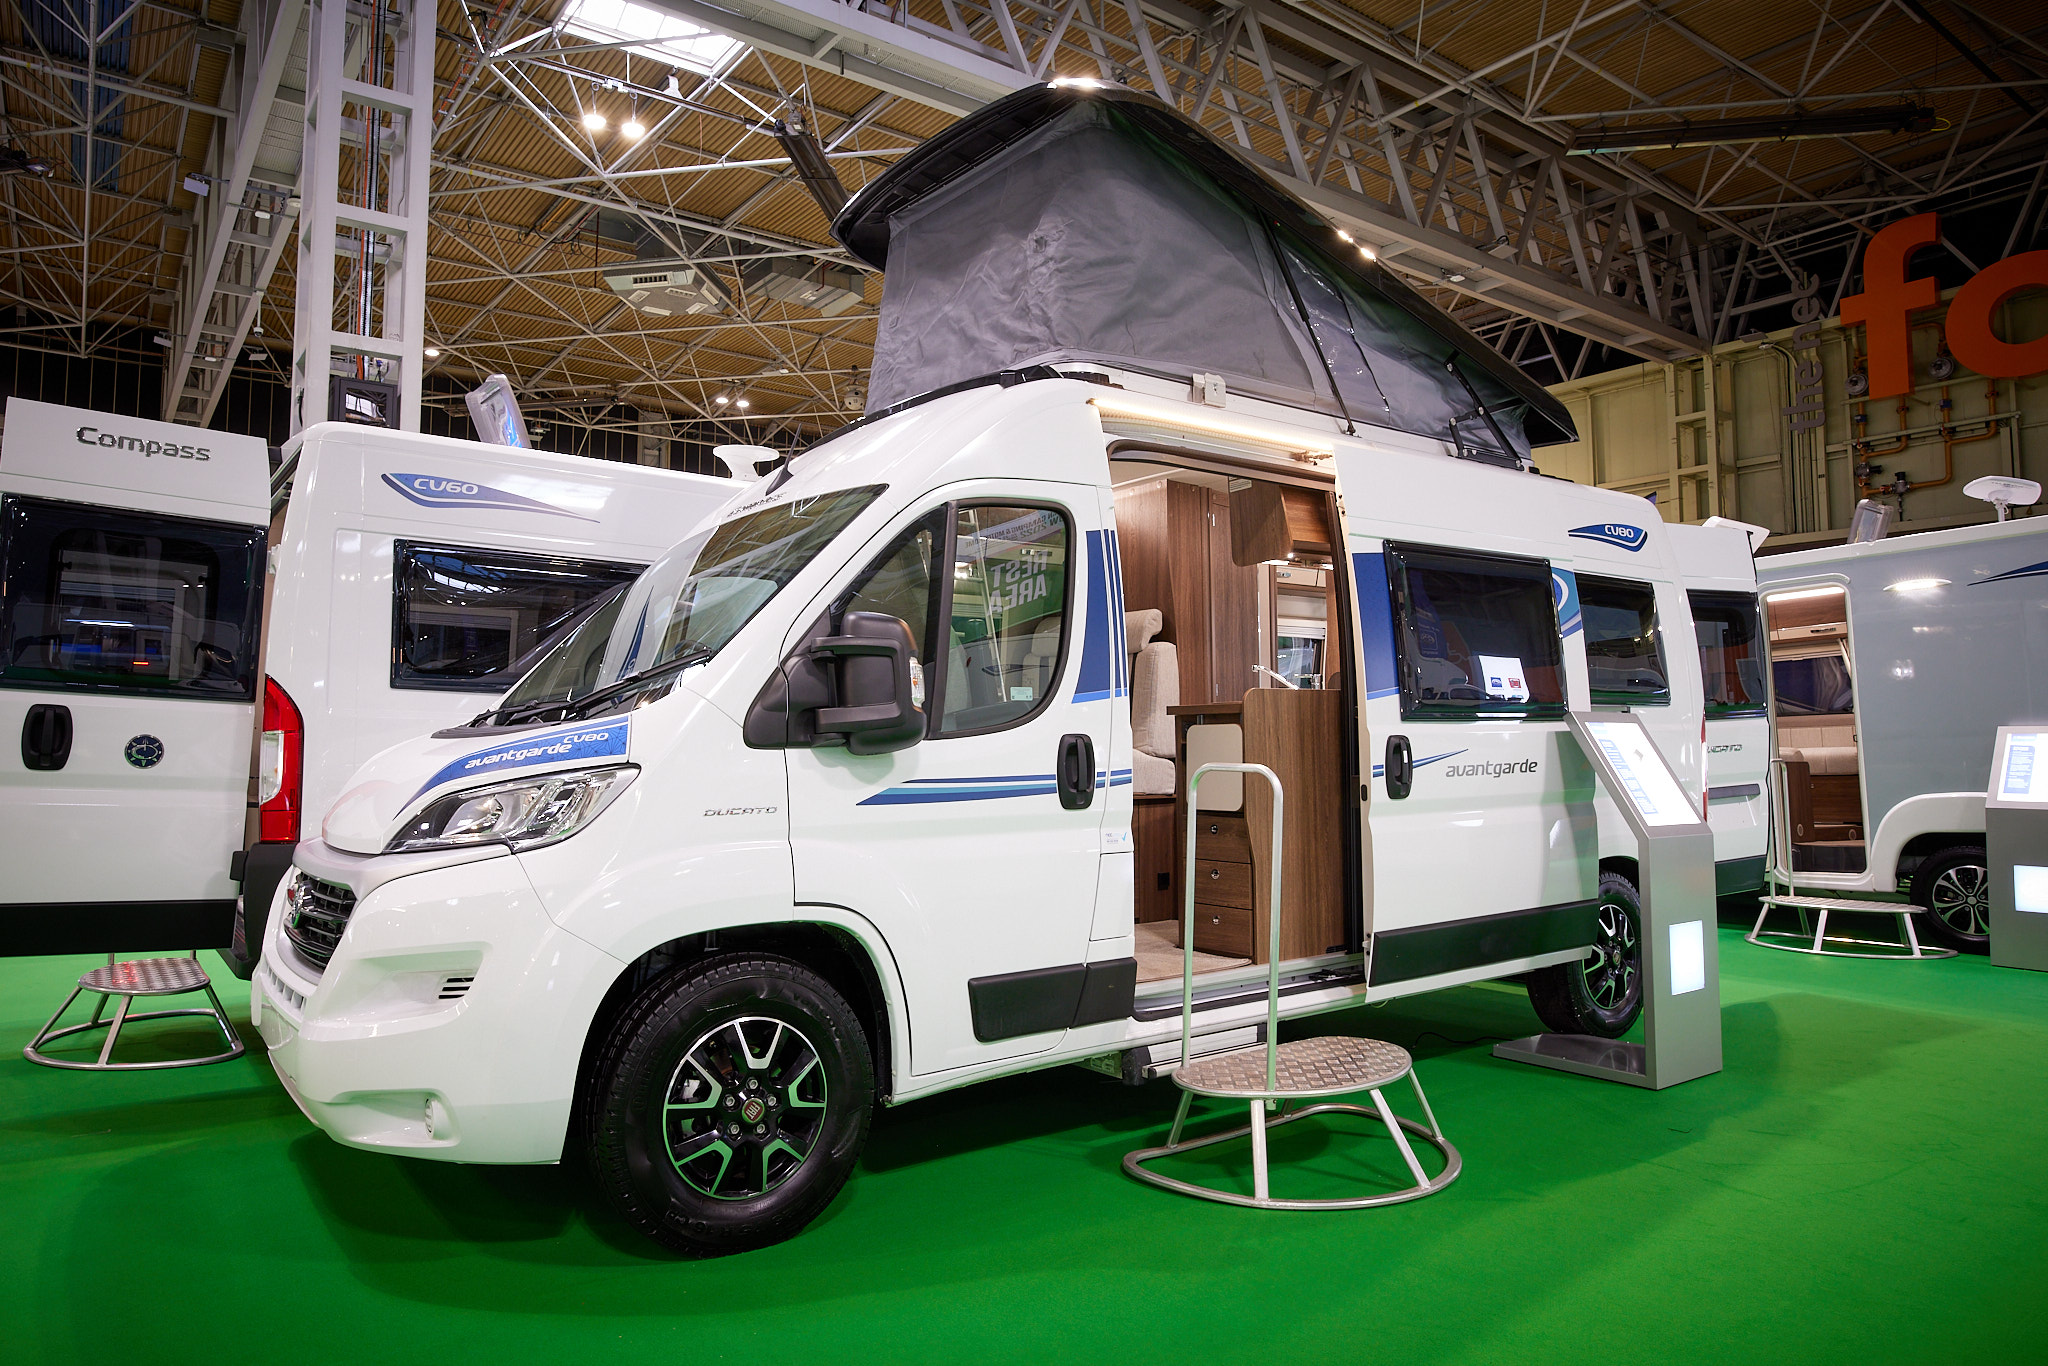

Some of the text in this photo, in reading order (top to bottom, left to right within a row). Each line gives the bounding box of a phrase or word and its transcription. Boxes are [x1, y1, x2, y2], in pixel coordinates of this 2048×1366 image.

[1783, 272, 1825, 434] the nec
[76, 426, 211, 461] Compass
[413, 478, 479, 495] CV60
[1604, 525, 1634, 538] CV80
[465, 743, 572, 769] avantgarde
[1446, 759, 1538, 778] avantgarde
[704, 807, 777, 817] DUCATO
[745, 1102, 761, 1120] FIAT
